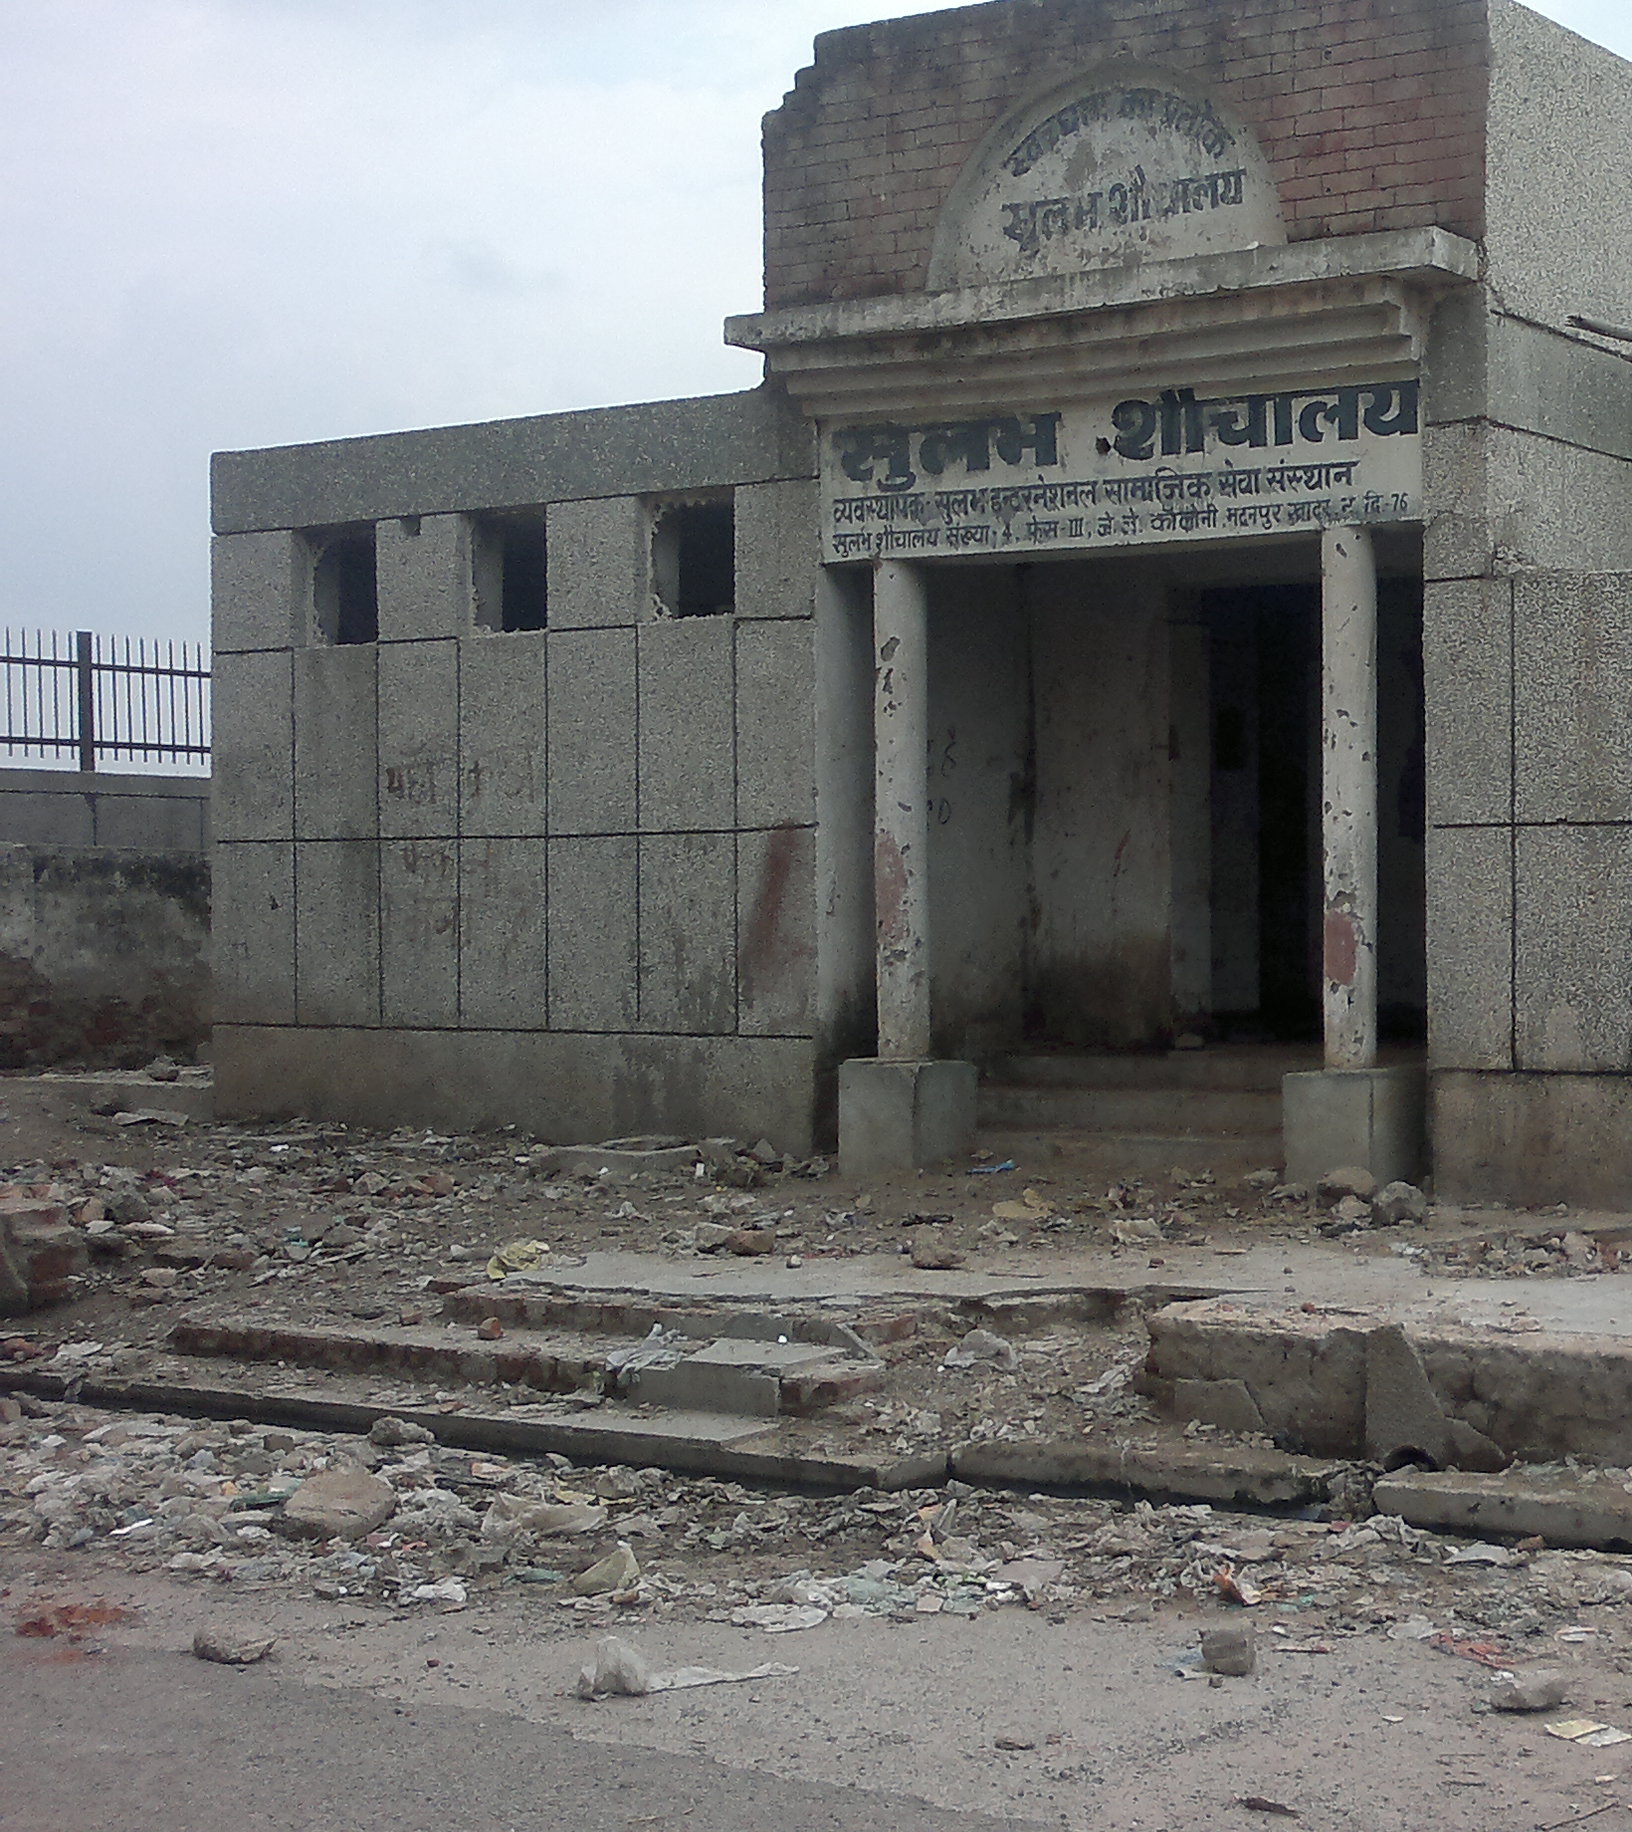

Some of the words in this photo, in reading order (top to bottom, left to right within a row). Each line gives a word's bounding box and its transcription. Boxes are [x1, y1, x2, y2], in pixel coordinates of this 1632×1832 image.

[832, 412, 1062, 493] सुलभ
[1111, 378, 1420, 461] शौचालय
[934, 487, 989, 526] सुलभ
[1103, 466, 1213, 506] सामाजिक
[1217, 457, 1262, 499] सेवा
[1265, 457, 1361, 494] संस्थान
[831, 528, 873, 558] सुलभ
[874, 523, 941, 553] शौचालय
